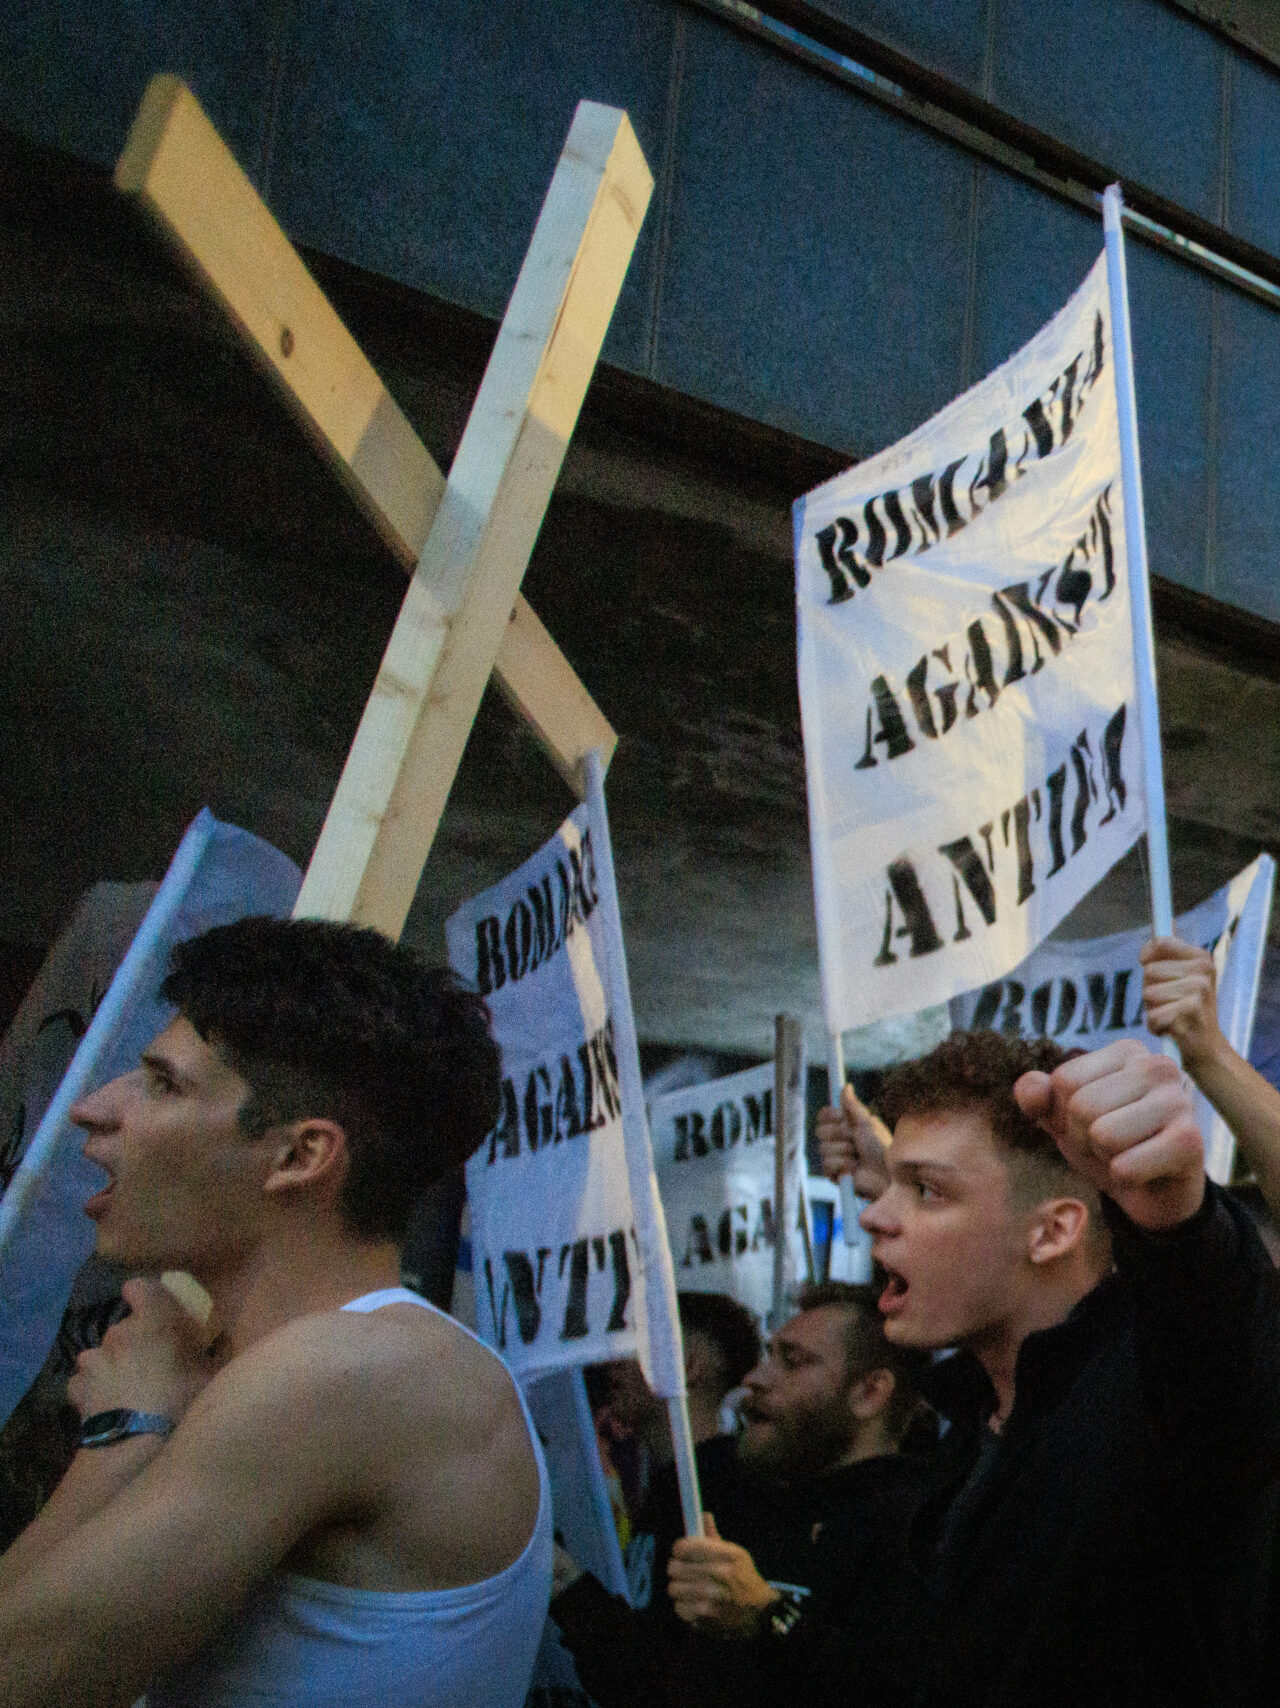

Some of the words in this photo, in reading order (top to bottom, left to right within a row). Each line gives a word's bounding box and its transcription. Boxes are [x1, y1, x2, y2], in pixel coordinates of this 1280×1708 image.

[815, 308, 1104, 605] ROMANIA
[854, 482, 1116, 770] AGAINST
[874, 702, 1127, 967] ANTIFA
[487, 1013, 622, 1166] AGAIN
